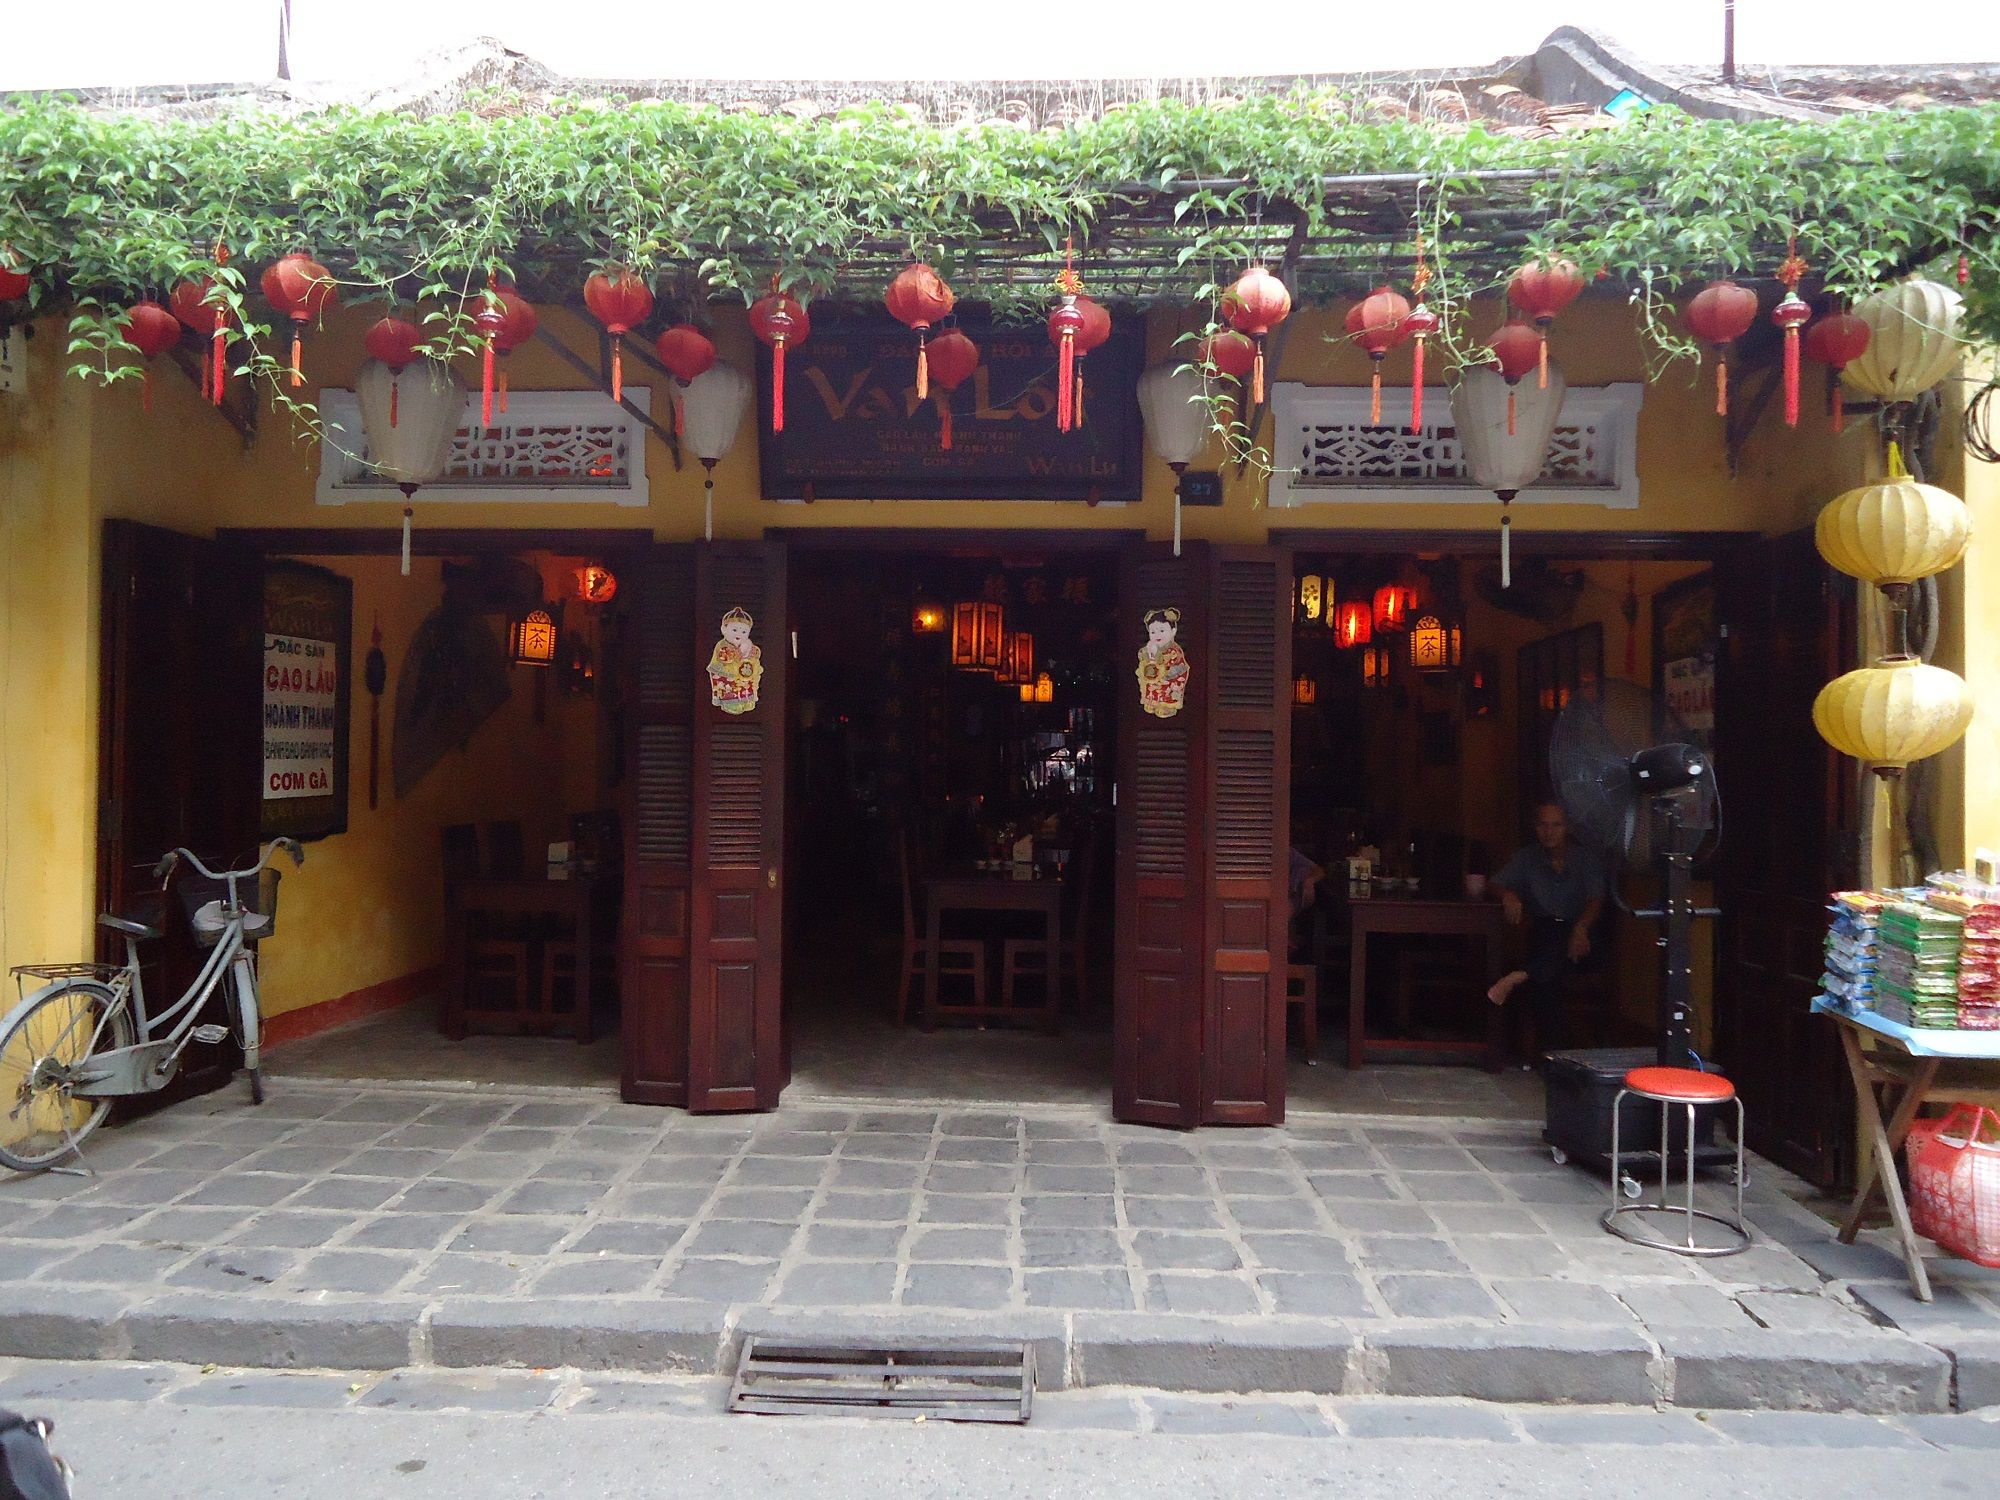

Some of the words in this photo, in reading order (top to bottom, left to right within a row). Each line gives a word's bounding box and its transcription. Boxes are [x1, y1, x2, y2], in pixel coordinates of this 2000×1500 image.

[528, 627, 547, 649] 茶
[1419, 635, 1439, 658] 茶
[266, 665, 302, 693] CAO
[309, 767, 328, 789] GÀ
